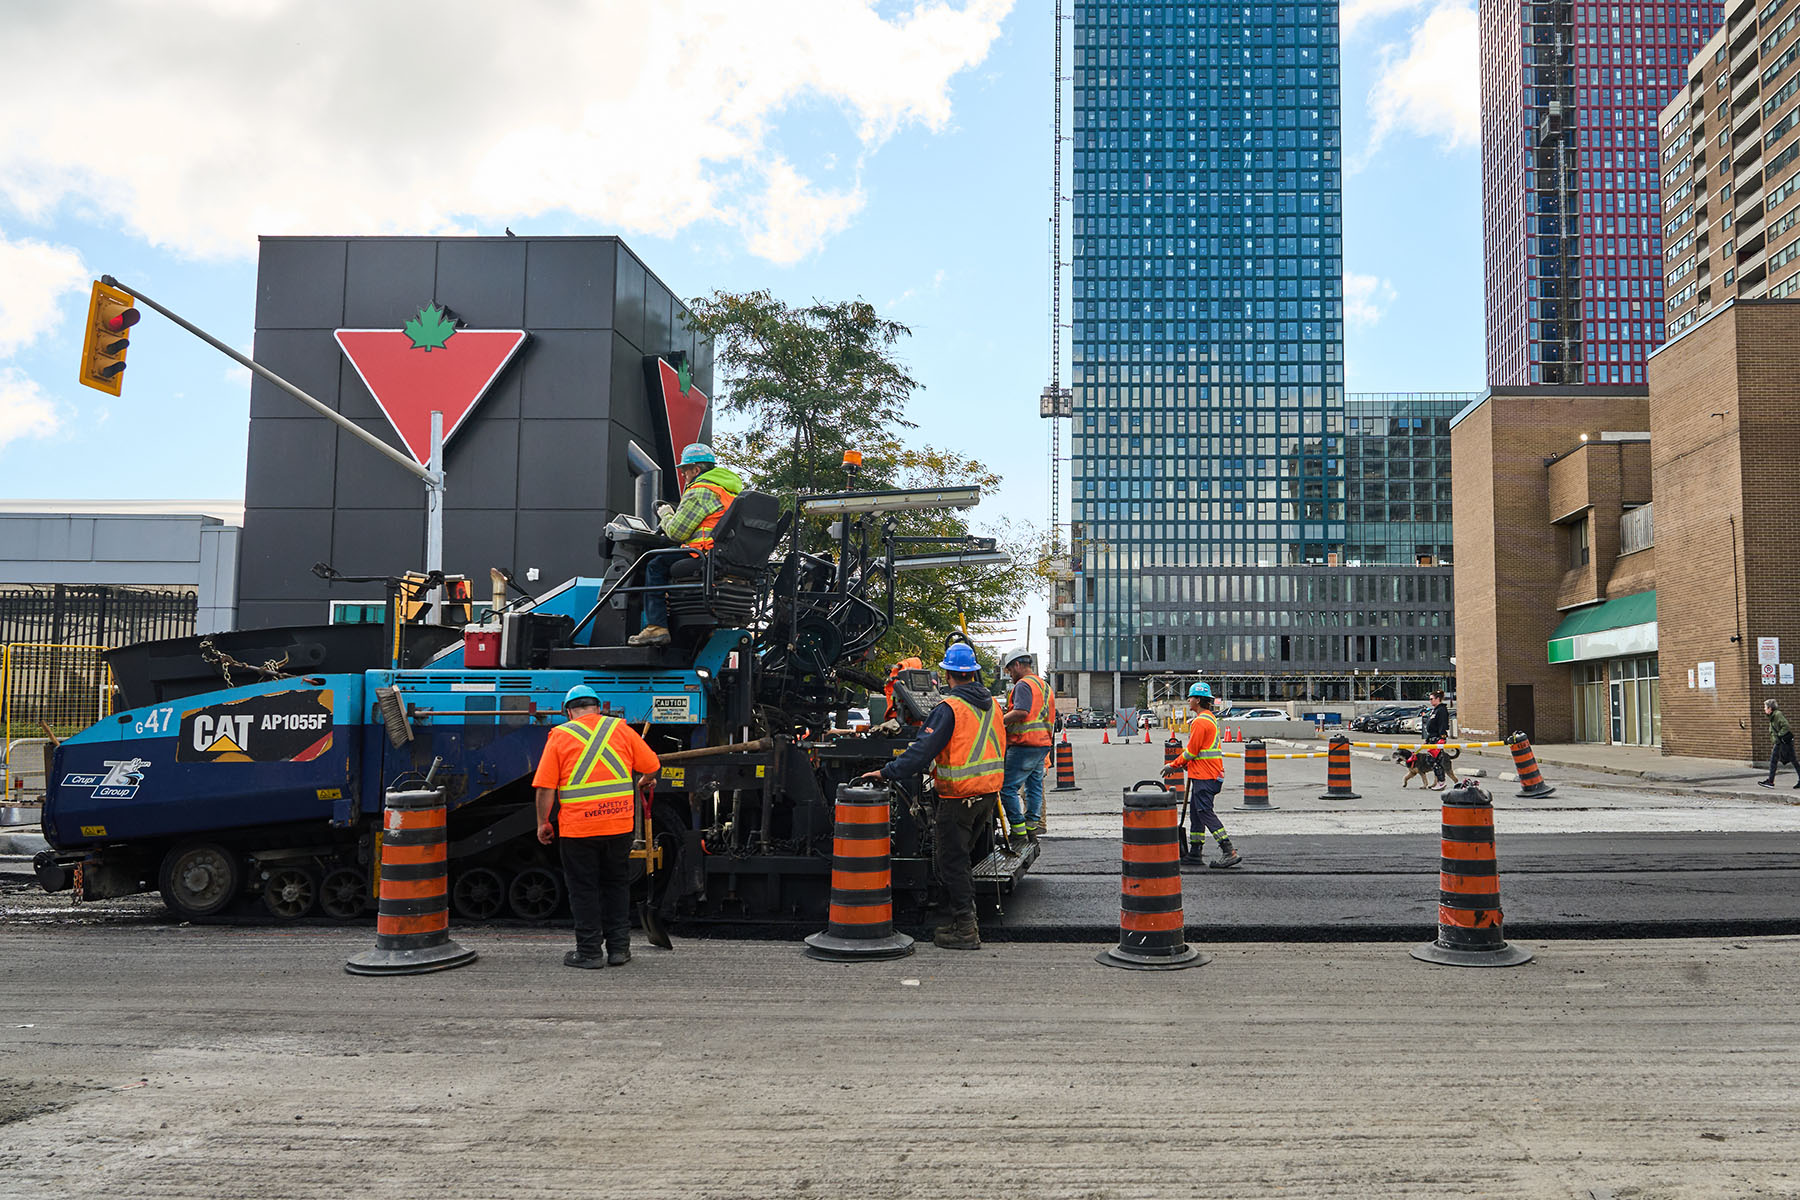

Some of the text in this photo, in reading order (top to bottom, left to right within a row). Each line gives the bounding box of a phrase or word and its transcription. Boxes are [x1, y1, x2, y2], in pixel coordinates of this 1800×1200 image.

[655, 699, 687, 707] CAUTION
[193, 714, 327, 752] CAT AP1055F
[71, 776, 97, 785] Crupi
[100, 787, 130, 797] Group
[598, 801, 622, 809] SAFETY
